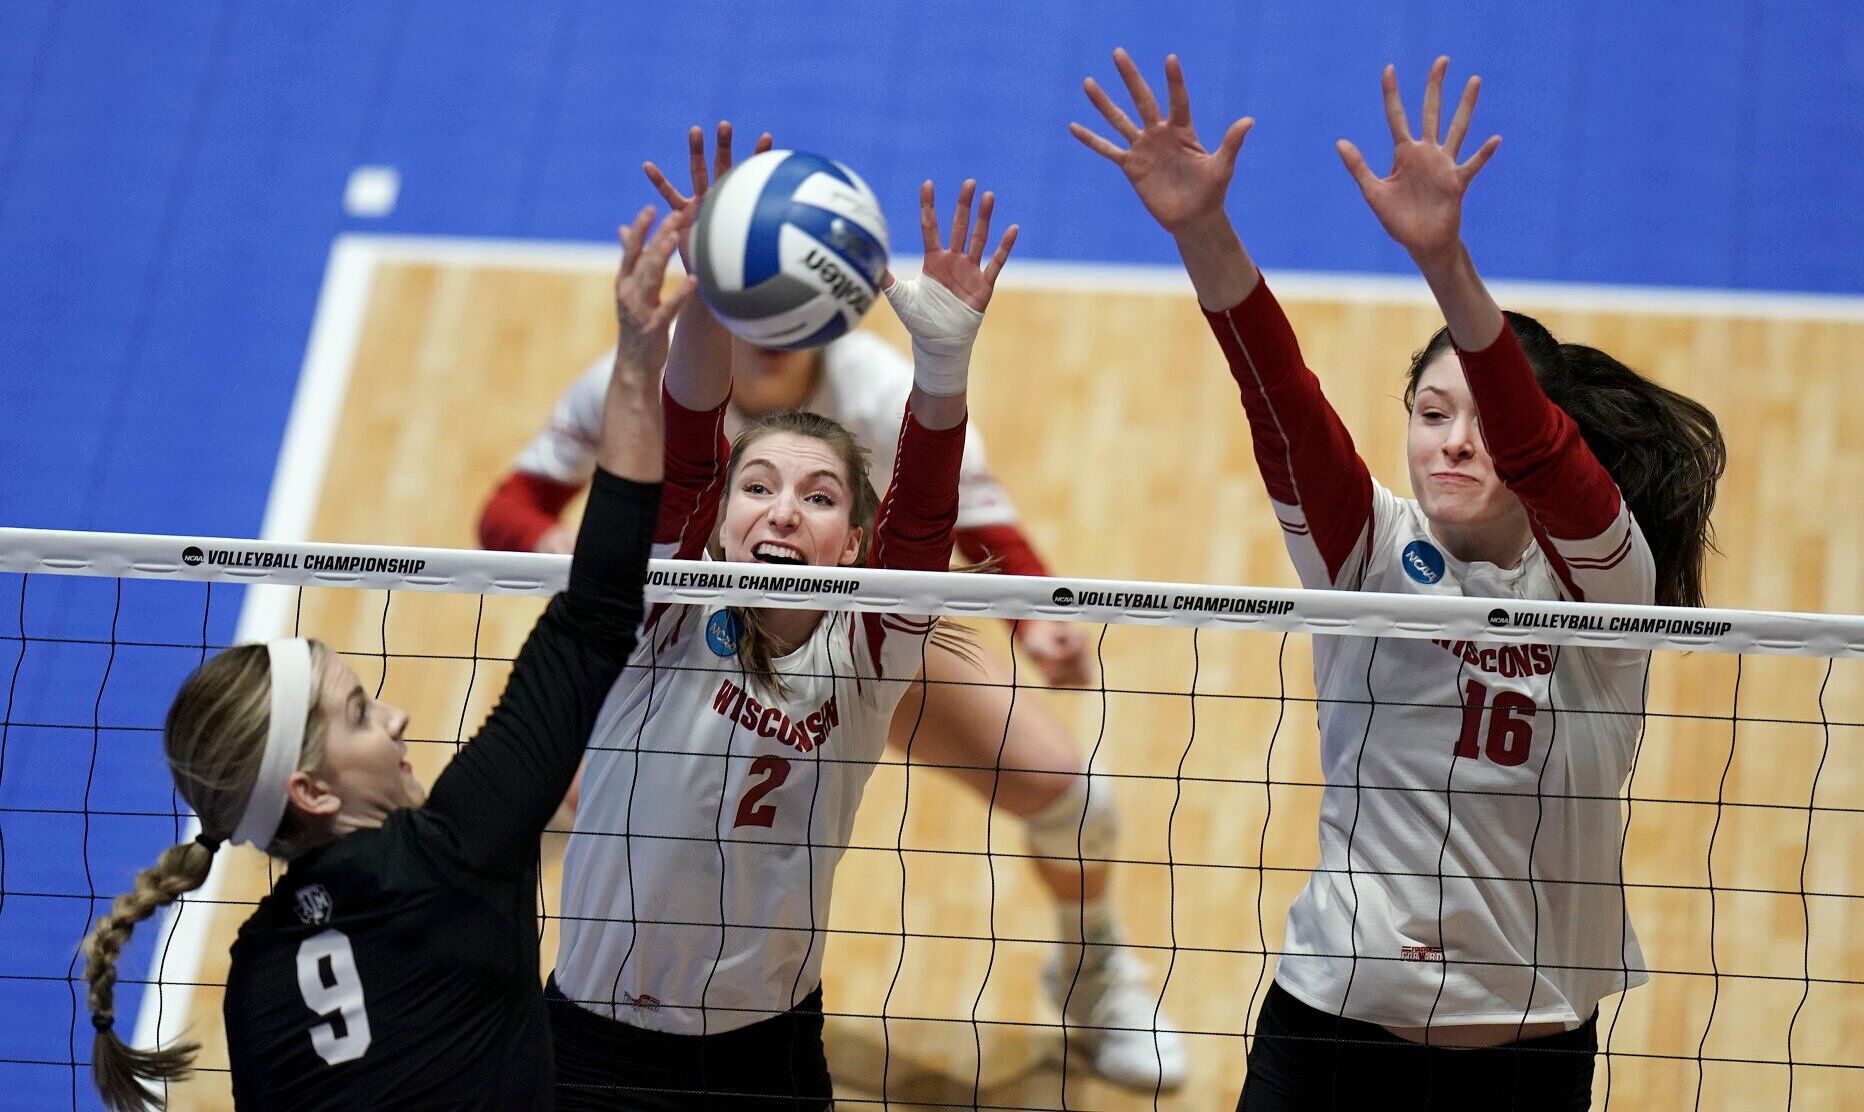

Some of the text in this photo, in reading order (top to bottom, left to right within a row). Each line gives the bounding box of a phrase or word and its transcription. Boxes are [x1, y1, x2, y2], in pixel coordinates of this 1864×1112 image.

[208, 549, 298, 569] VOLLEYBALL
[303, 554, 426, 574] CHAMPIONSHIP
[1405, 550, 1438, 582] NCAA
[645, 570, 860, 594] VOLLEYBALL CHAMPIONSHIP
[1078, 591, 1168, 610] VOLLEYBALL
[1172, 595, 1295, 615] CHAMPIONSHIP
[1513, 612, 1604, 631] VOLLEYBALL
[1608, 616, 1732, 636] CHAMPIONSHIP
[712, 678, 839, 753] WISCONSIN
[1453, 679, 1536, 767] 16
[733, 755, 791, 828] 2
[296, 927, 372, 1066] 9
